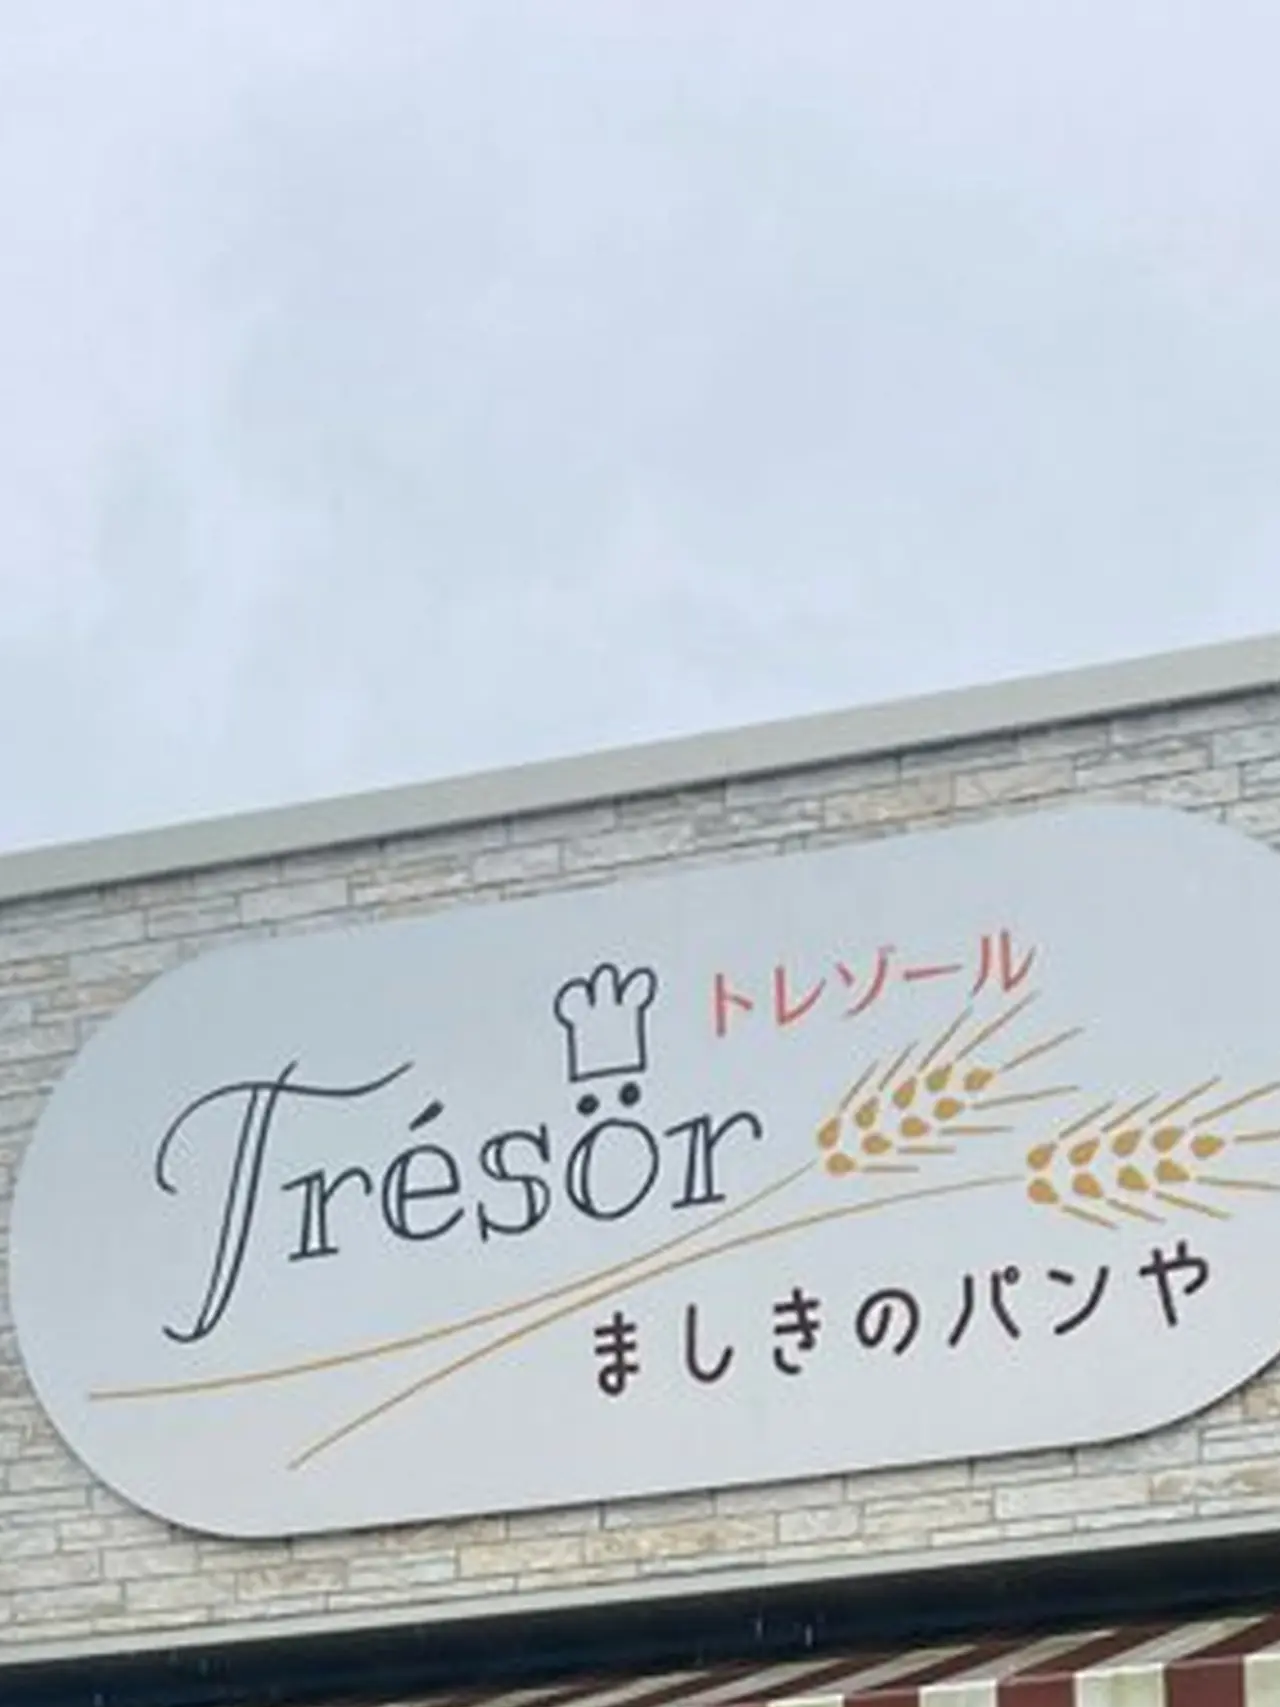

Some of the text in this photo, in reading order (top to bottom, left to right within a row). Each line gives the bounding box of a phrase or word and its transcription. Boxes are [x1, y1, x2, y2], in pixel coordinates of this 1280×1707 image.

[713, 928, 1038, 1038] トレゾール
[593, 1240, 1210, 1396] ましきのパンや
